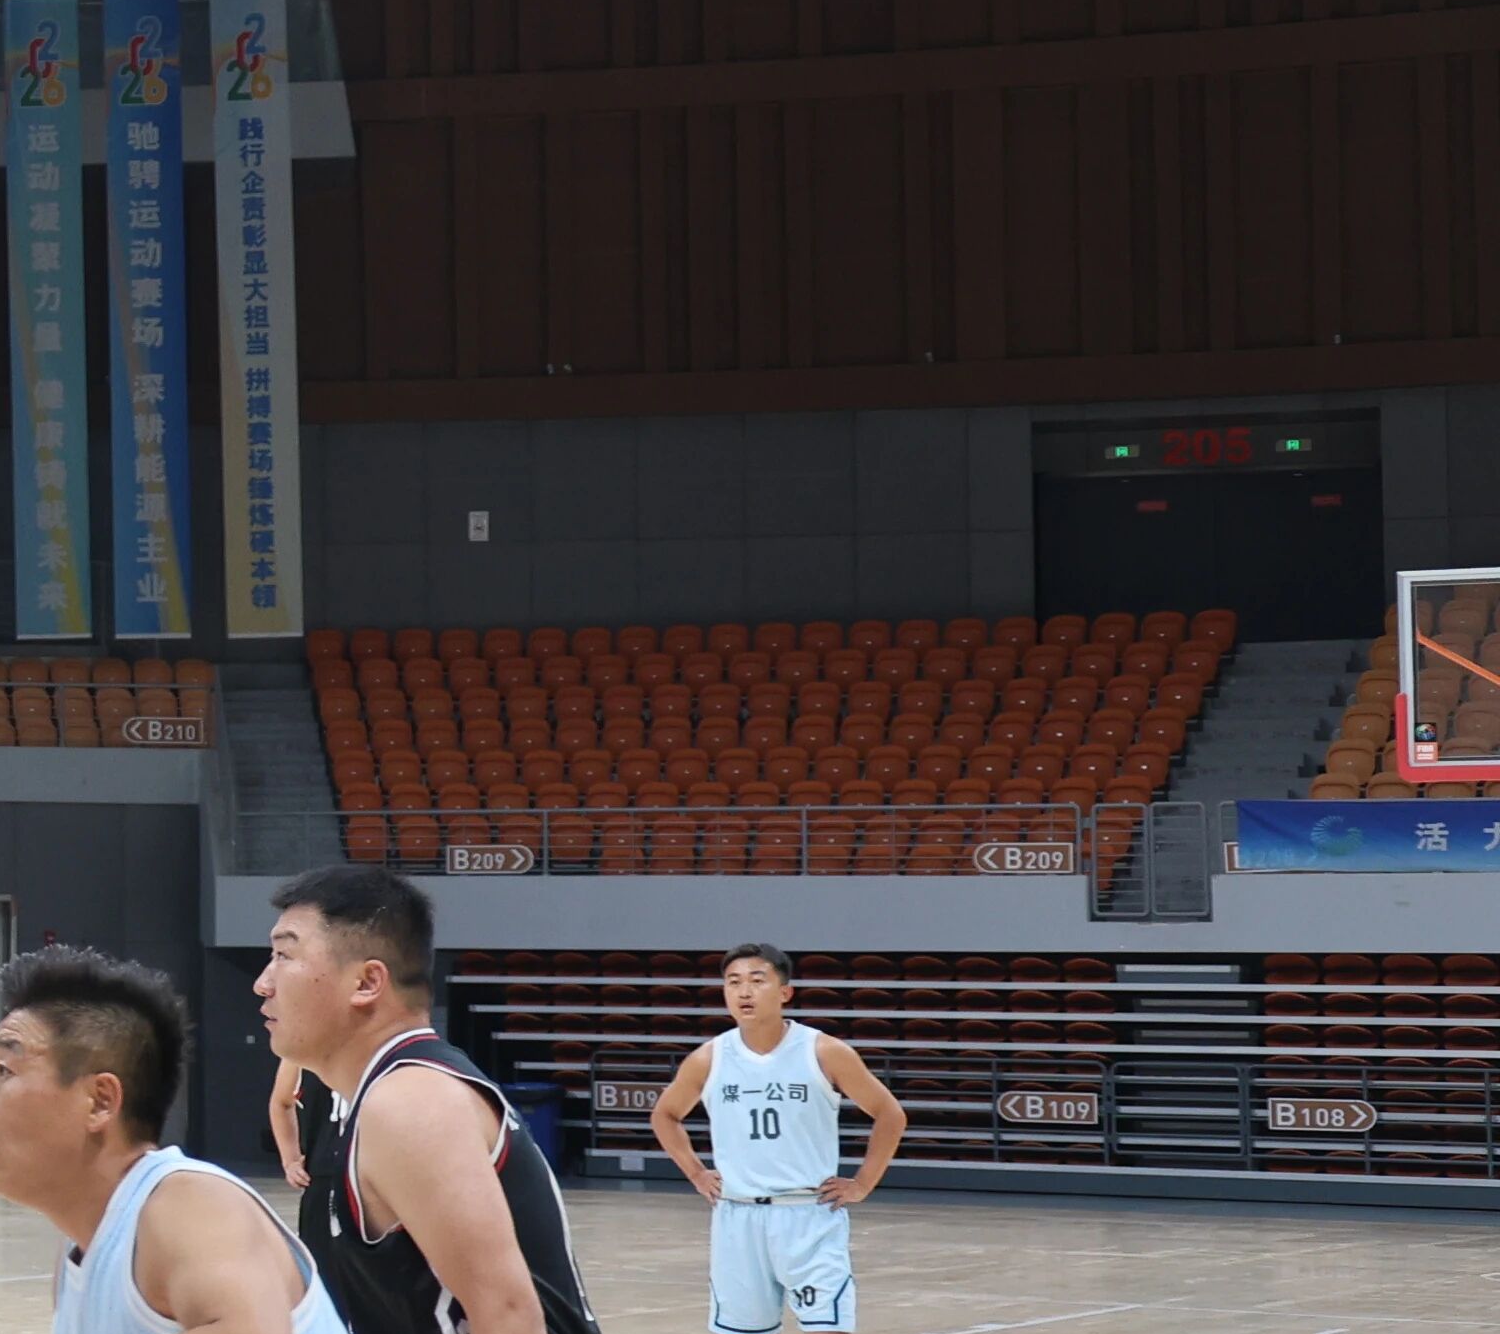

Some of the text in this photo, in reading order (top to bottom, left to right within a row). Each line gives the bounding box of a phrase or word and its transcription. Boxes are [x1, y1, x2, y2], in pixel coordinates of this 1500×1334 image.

[127, 120, 164, 348] 驰骋运动赛场
[1162, 426, 1254, 466] 205
[147, 720, 197, 742] B210
[453, 847, 505, 872] B209
[1004, 845, 1064, 870] B209
[601, 1081, 656, 1110] B109
[722, 1083, 808, 1103] 煤一公司
[1026, 1096, 1091, 1123] B109
[1276, 1102, 1345, 1127] B108
[749, 1108, 780, 1140] 10
